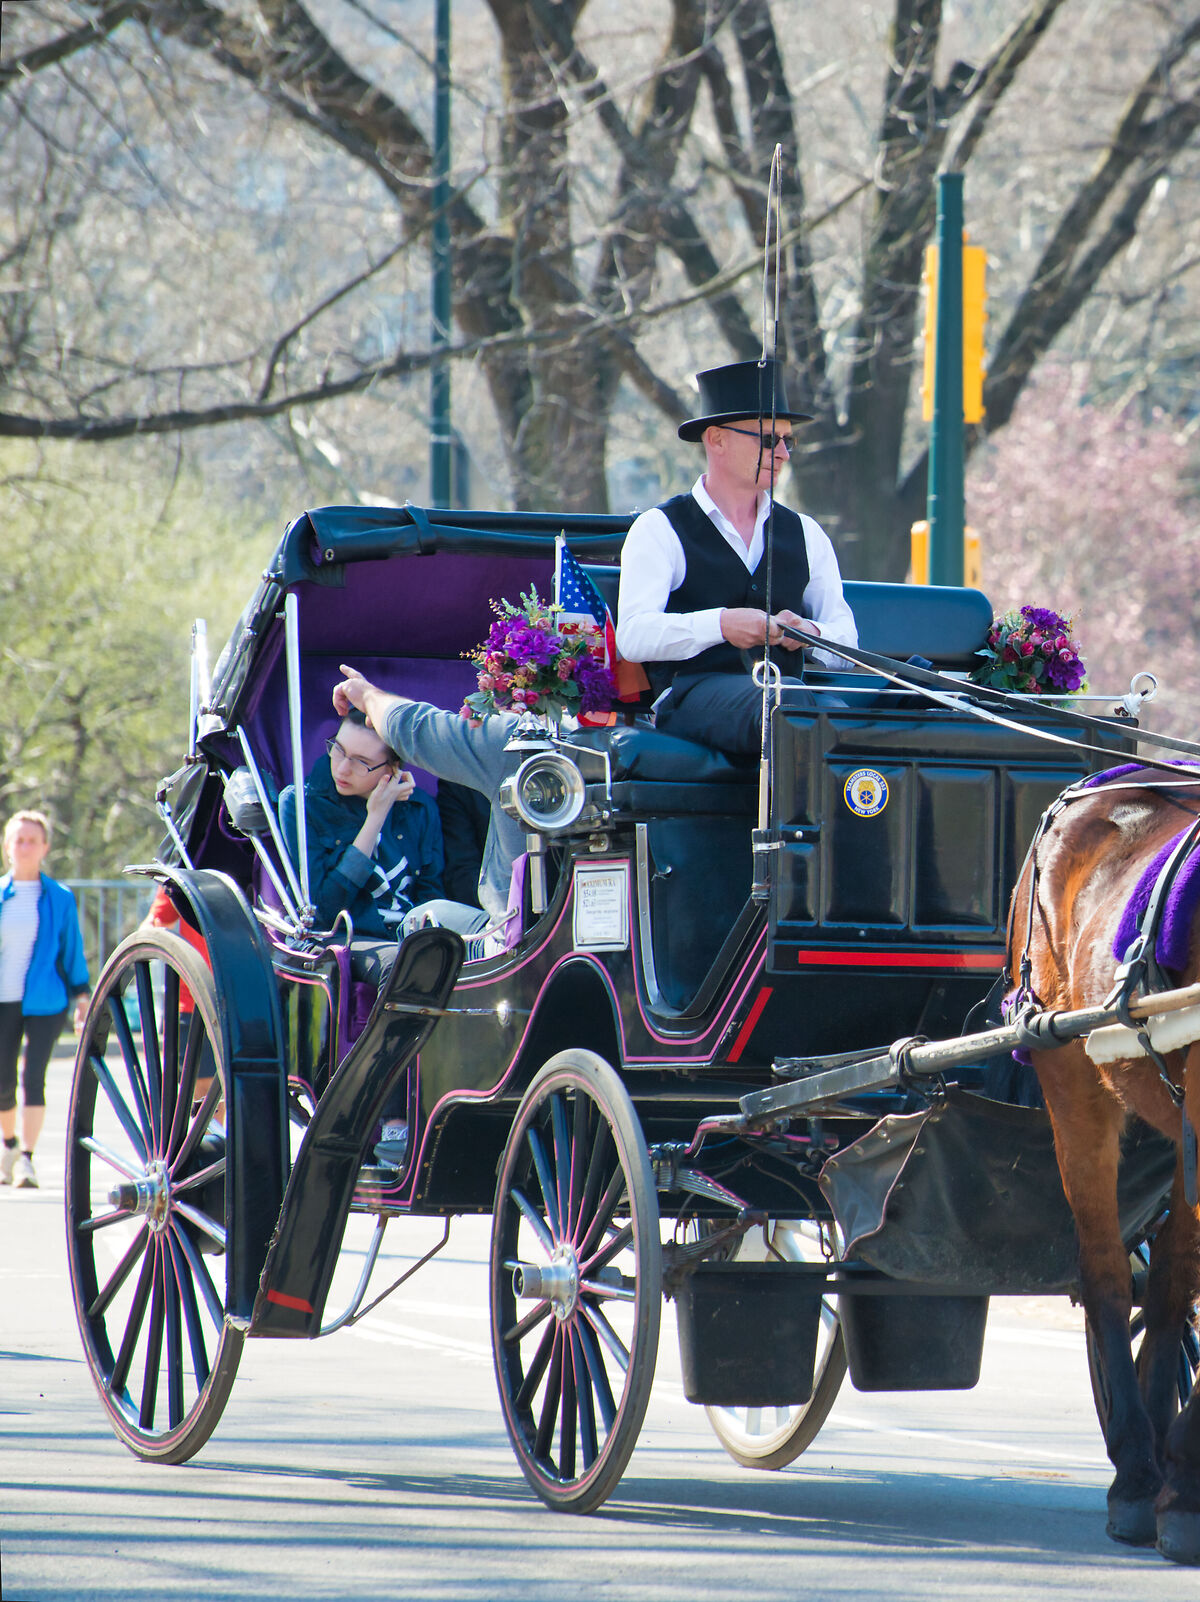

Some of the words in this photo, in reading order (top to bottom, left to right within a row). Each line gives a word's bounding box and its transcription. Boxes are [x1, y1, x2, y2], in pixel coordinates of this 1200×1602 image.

[846, 771, 866, 791] TEAMSTERS
[867, 771, 881, 781] LOCAL
[854, 806, 866, 814] NEW
[867, 806, 880, 815] YORK
